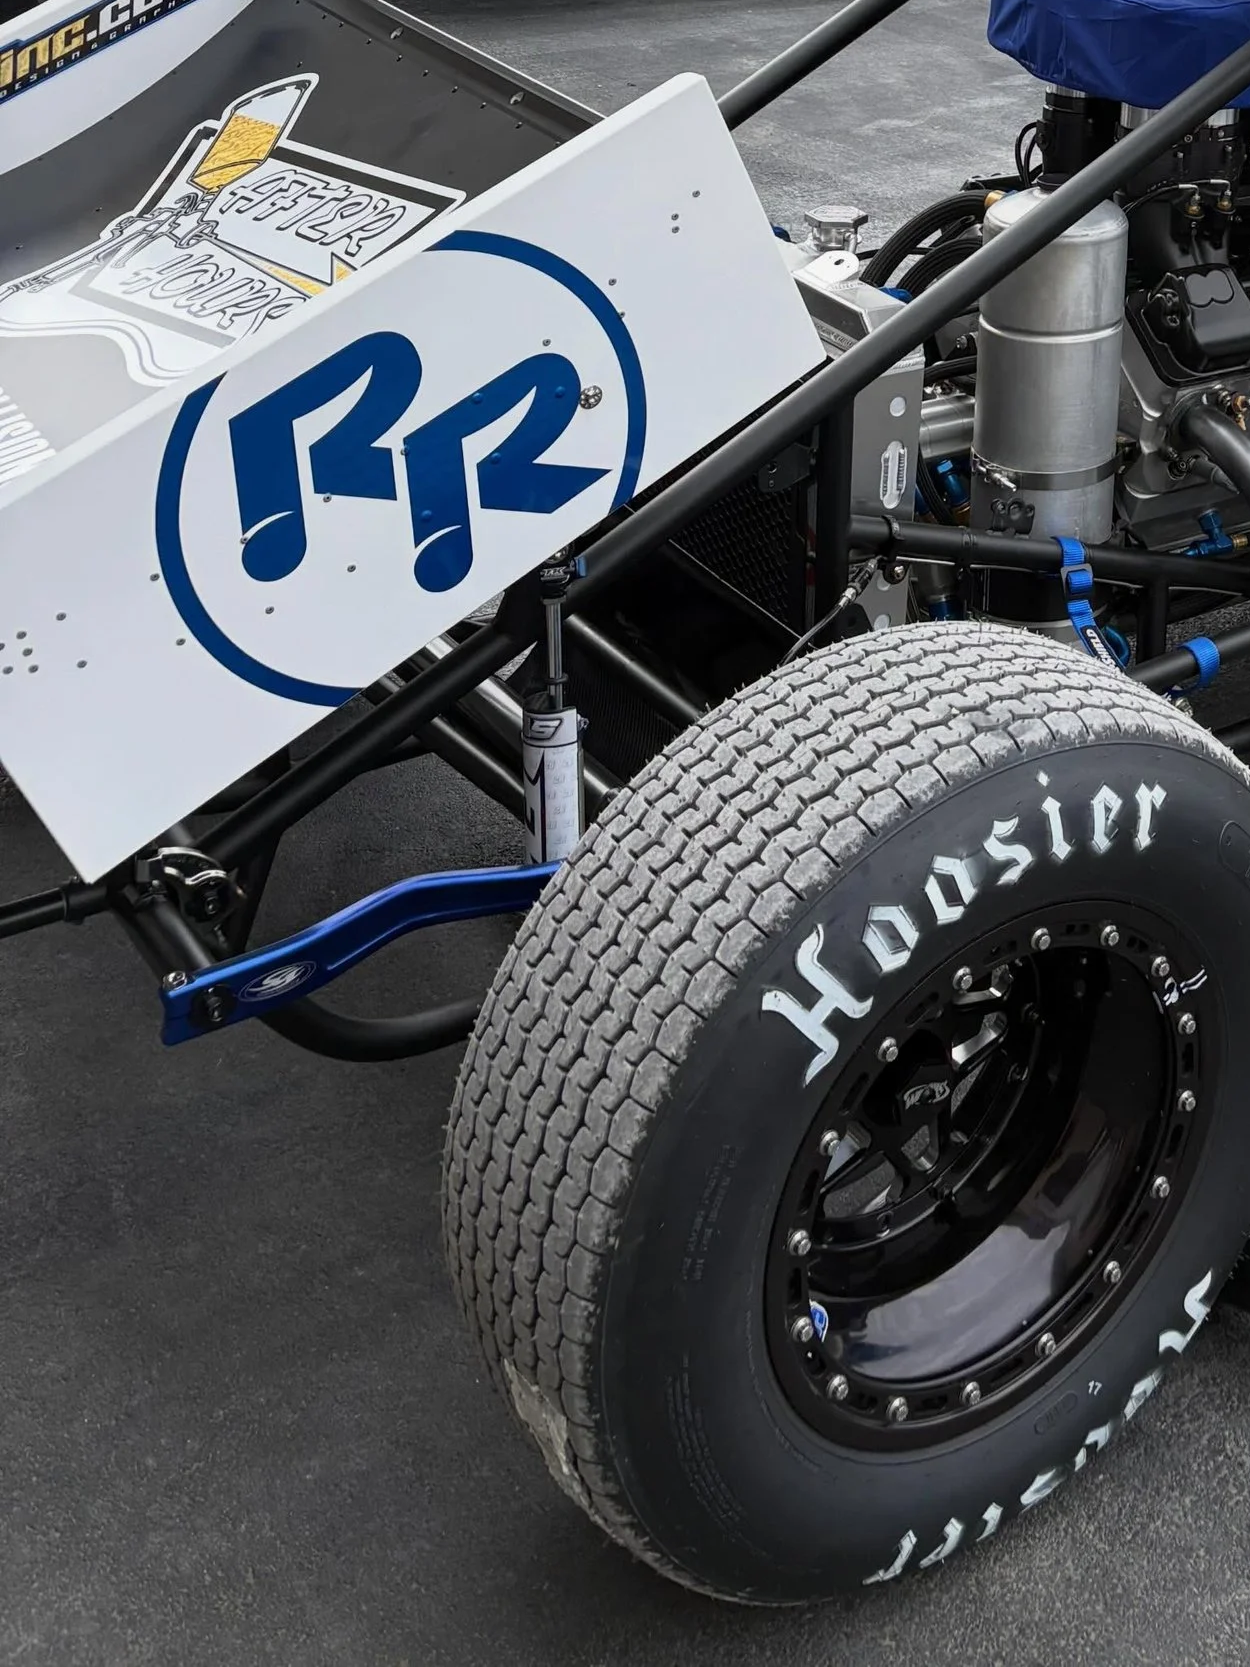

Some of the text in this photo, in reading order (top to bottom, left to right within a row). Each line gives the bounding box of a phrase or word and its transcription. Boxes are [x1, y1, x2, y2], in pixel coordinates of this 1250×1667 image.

[219, 168, 408, 257] AFTER
[761, 770, 1168, 1088] Hoosier
[1087, 1379, 1103, 1396] 17
